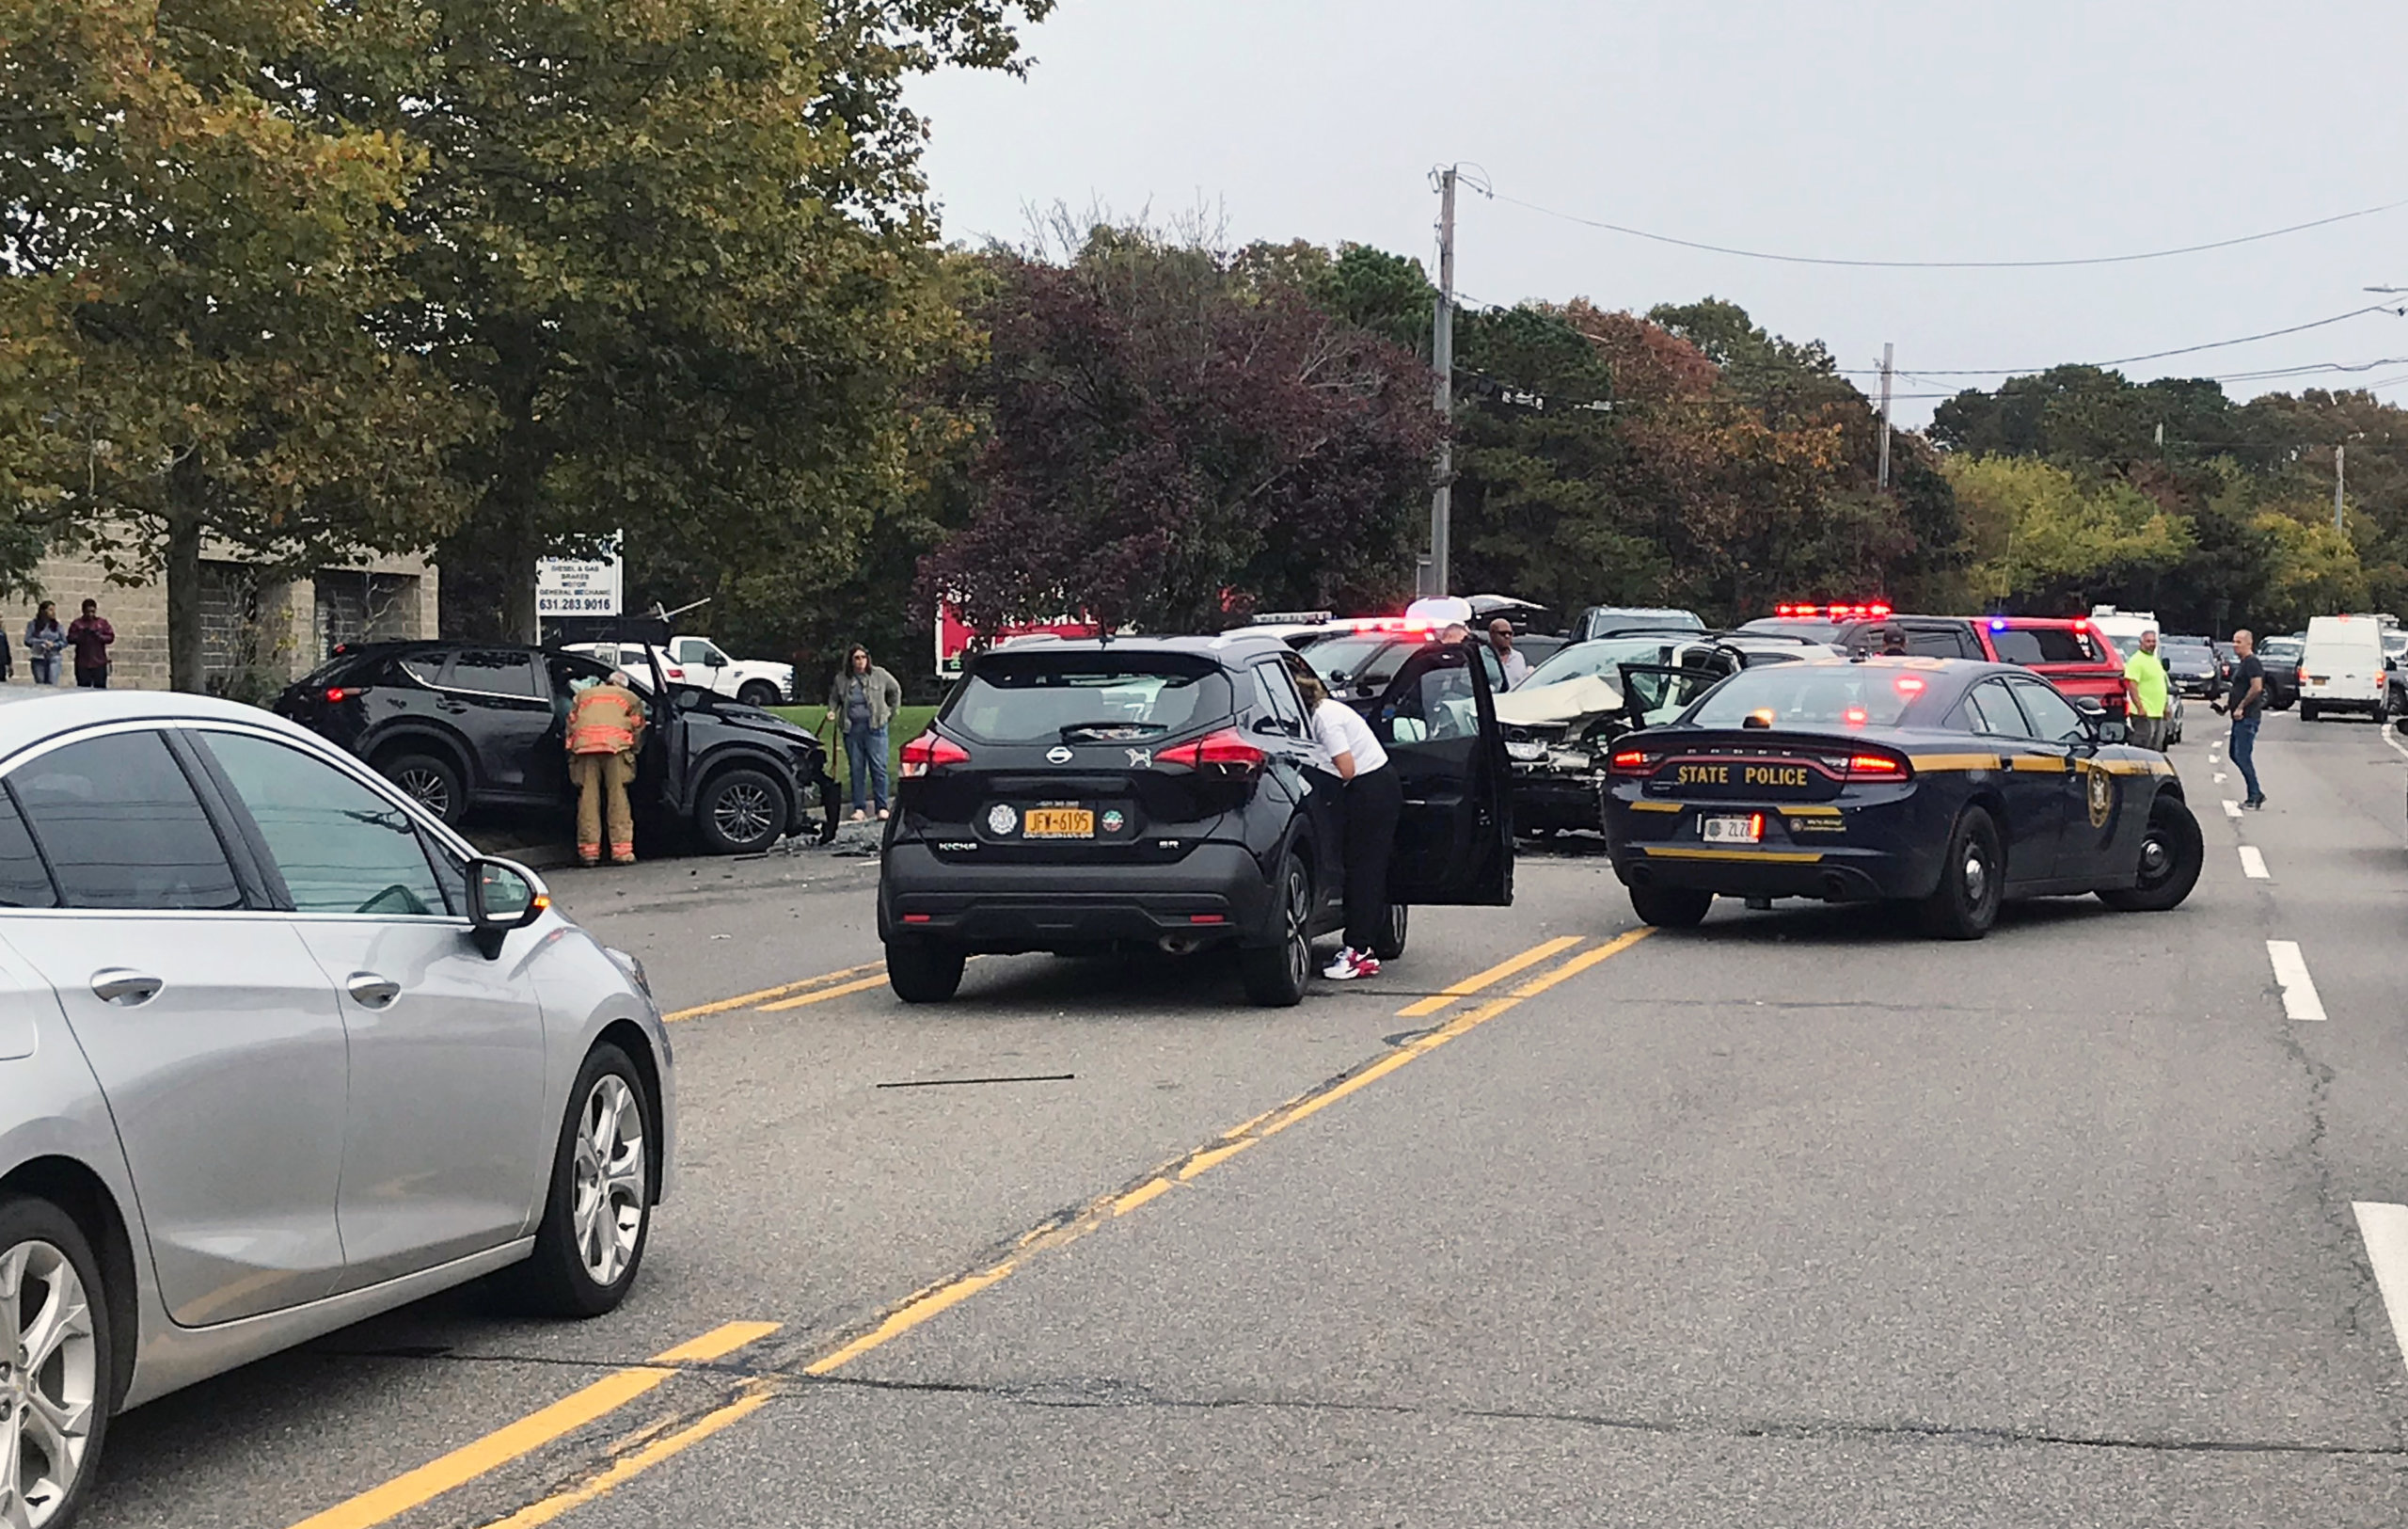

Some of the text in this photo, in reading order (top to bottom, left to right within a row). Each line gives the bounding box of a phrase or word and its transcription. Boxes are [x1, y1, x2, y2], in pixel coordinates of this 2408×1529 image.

[539, 598, 610, 610] 631.283.9016
[1678, 765, 1808, 785] STATE POLICE
[939, 842, 977, 851] KICKS
